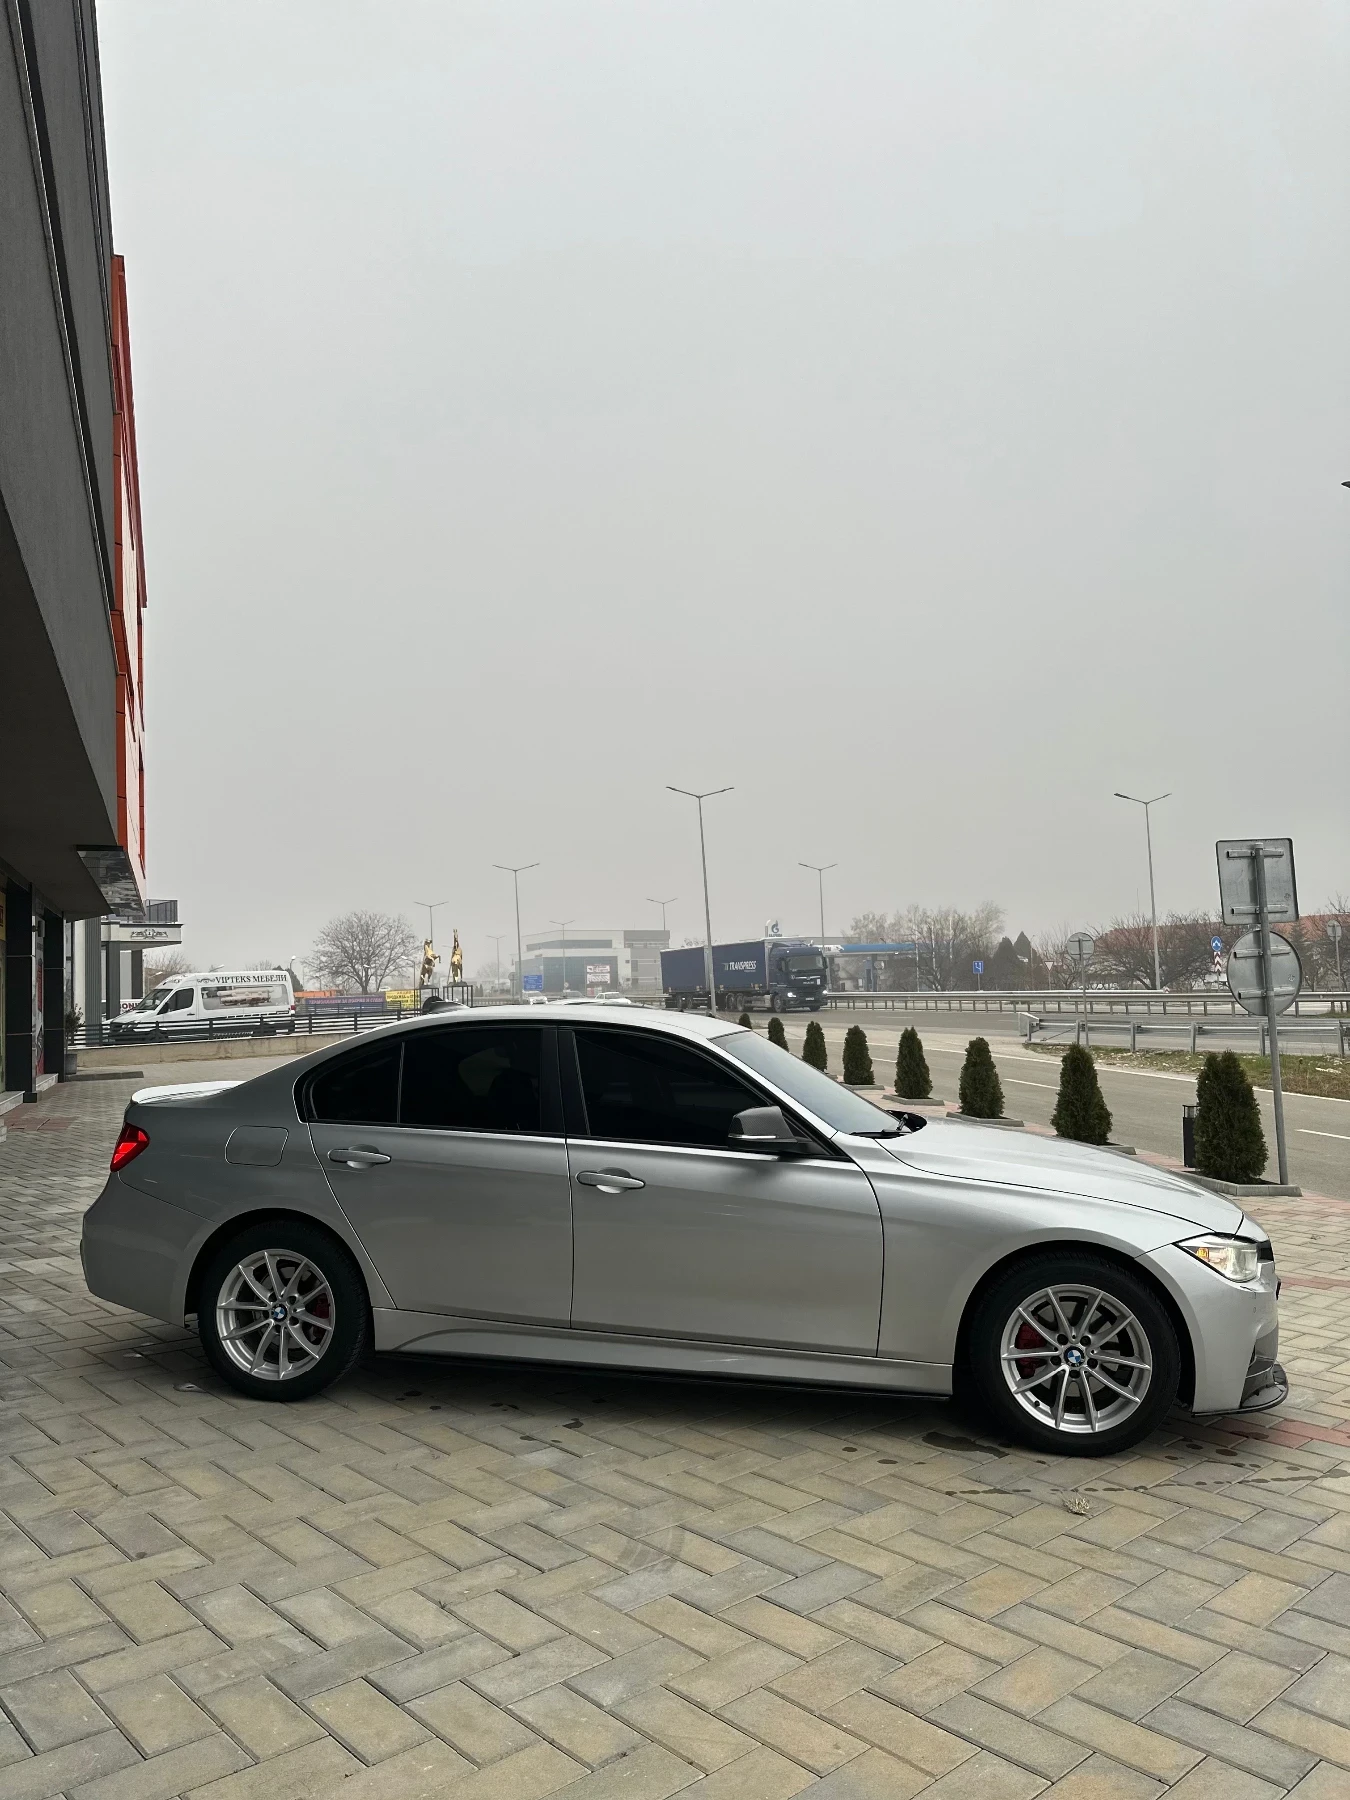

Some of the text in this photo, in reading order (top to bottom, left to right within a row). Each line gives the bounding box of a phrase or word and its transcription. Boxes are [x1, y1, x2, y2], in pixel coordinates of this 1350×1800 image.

[729, 960, 757, 970] TRANSPRESS
[215, 974, 287, 984] VIPTEKS МЕБЕЛИ
